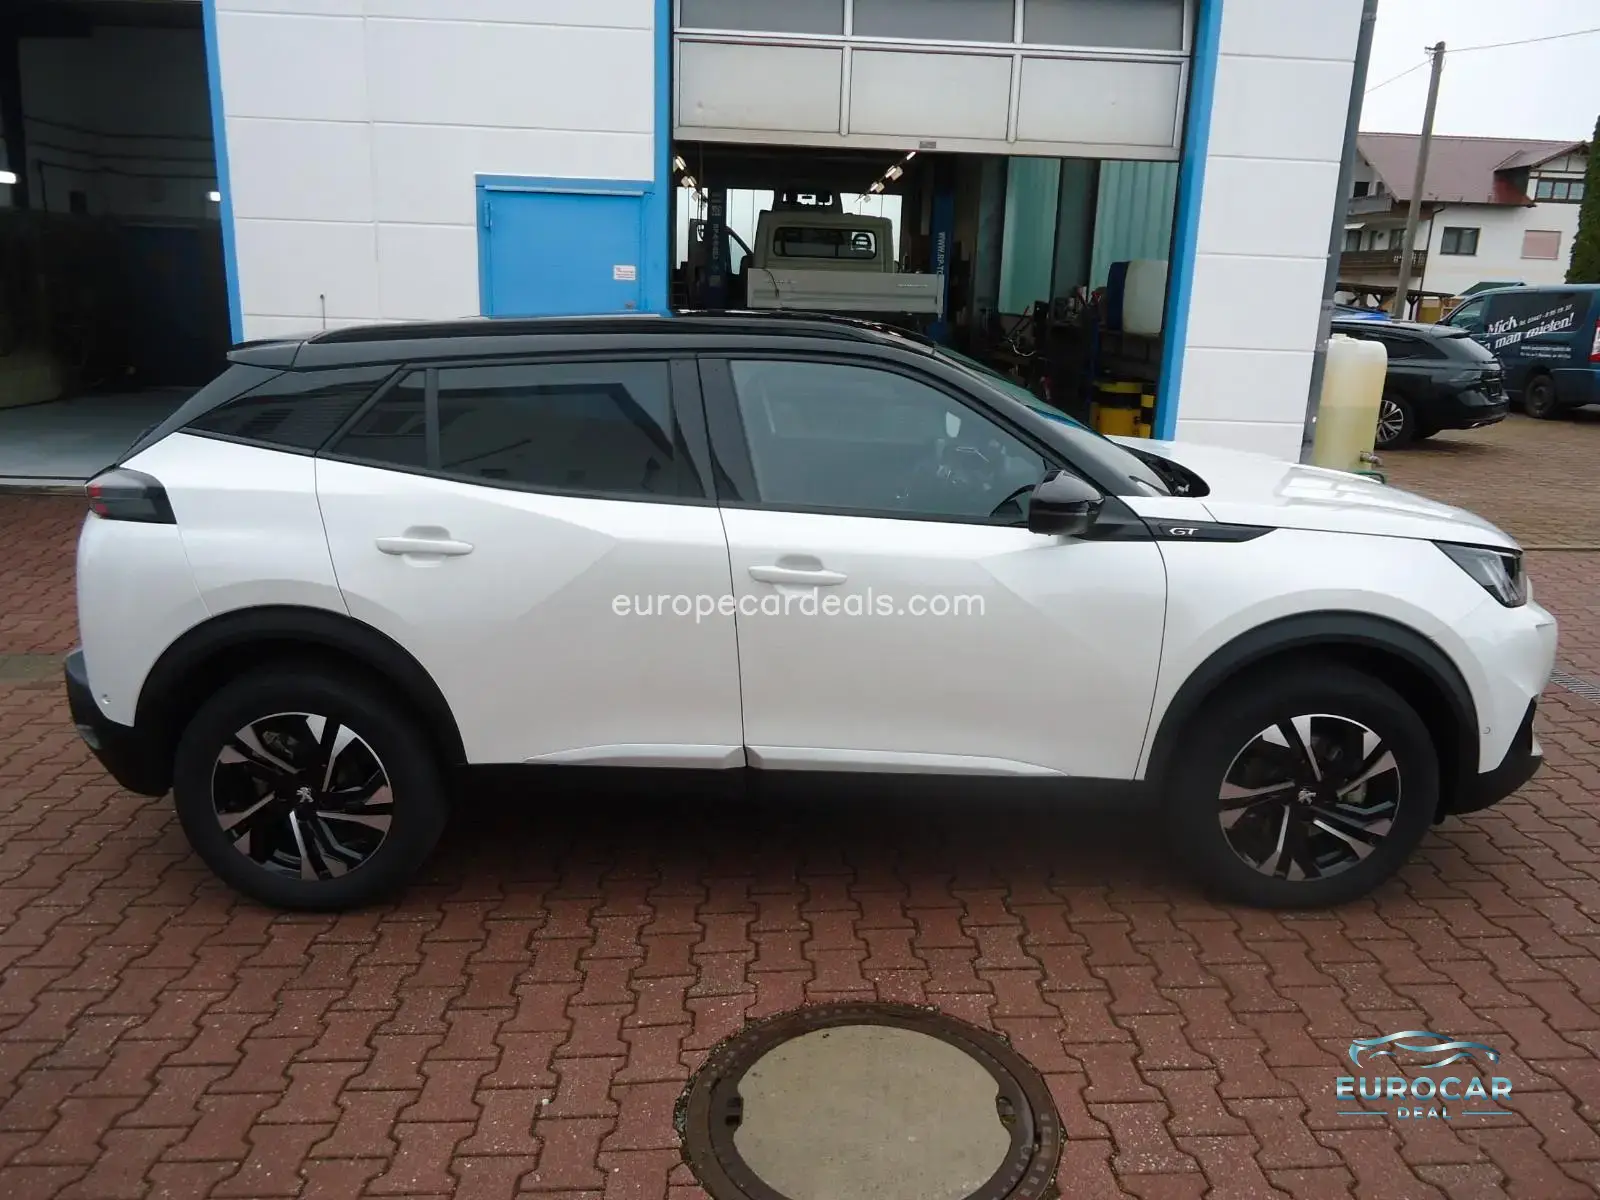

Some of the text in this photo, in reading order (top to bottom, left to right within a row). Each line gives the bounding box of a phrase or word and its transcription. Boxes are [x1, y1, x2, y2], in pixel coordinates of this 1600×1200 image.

[1488, 315, 1517, 334] Mich
[1495, 332, 1521, 349] man
[1525, 312, 1575, 338] mieten!
[1169, 527, 1199, 536] GT
